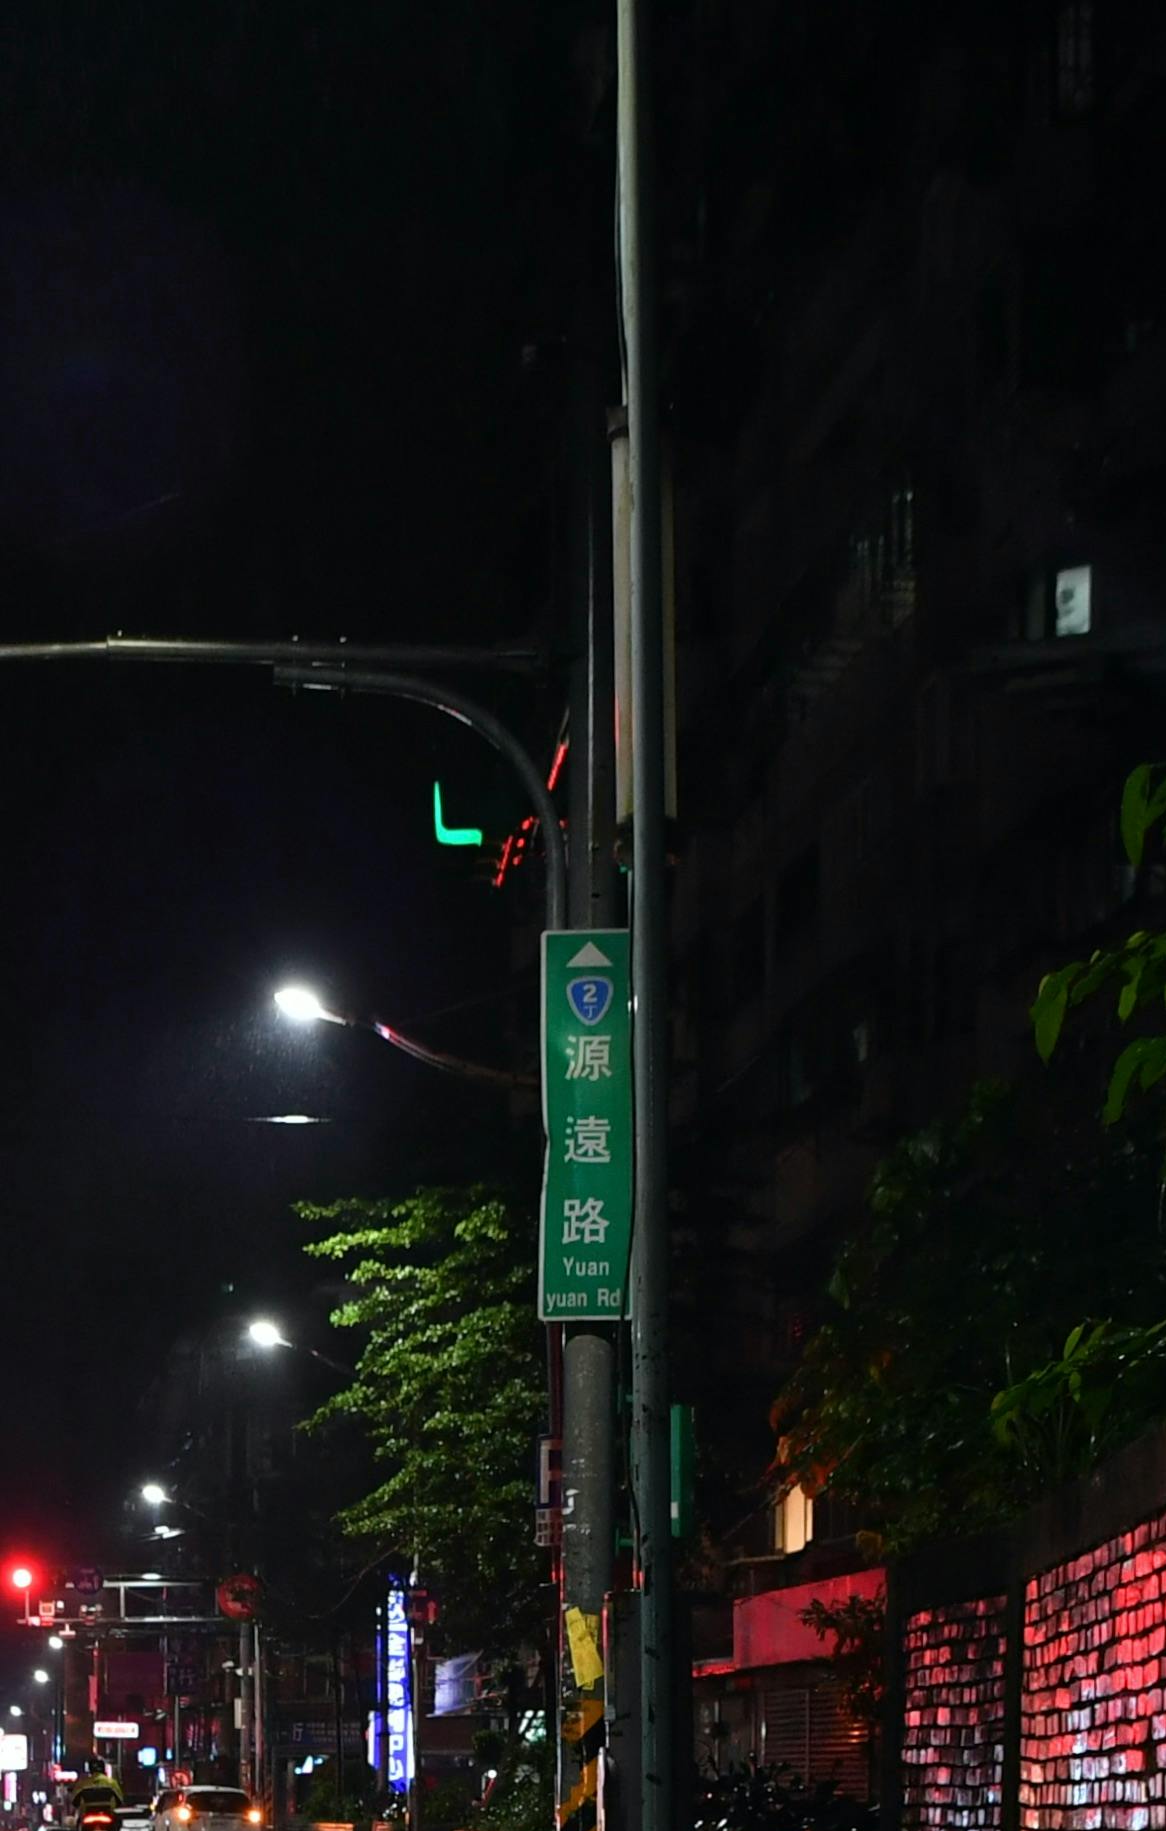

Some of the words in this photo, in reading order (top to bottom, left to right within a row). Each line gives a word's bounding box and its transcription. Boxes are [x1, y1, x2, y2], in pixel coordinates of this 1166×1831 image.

[583, 983, 598, 1004] 2
[562, 1035, 612, 1244] 源遠路
[562, 1256, 610, 1276] Yuan
[546, 1293, 588, 1312] yuan
[597, 1288, 621, 1307] Rd
